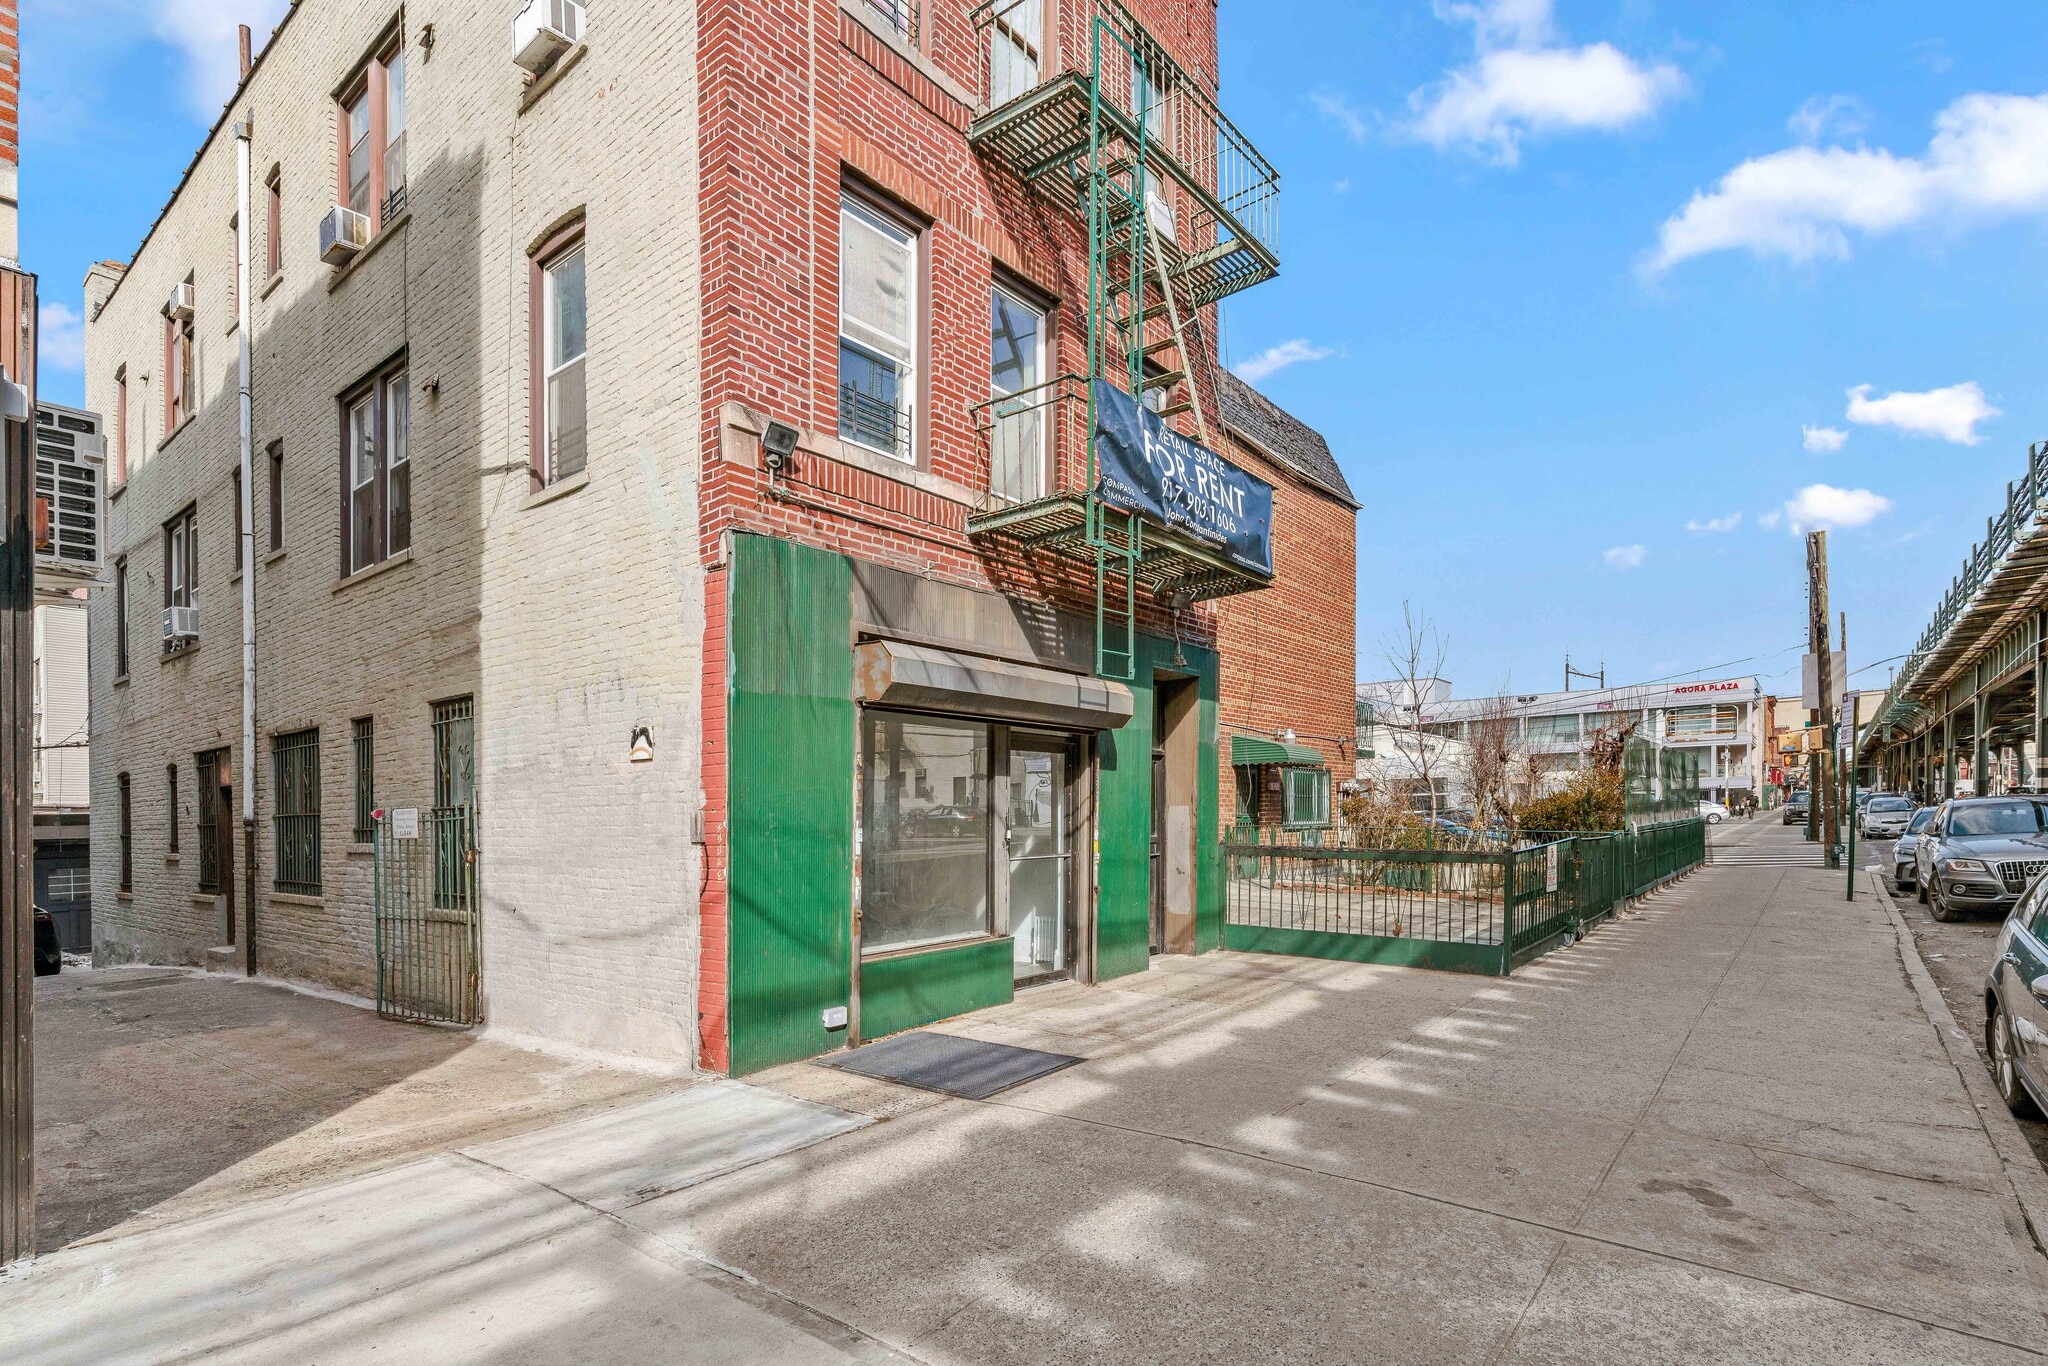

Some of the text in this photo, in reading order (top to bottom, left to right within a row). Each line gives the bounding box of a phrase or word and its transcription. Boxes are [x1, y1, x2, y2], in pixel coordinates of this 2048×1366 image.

[1143, 429, 1245, 518] FOR RENT
[1159, 426, 1226, 477] RETAIL SPACE
[1161, 477, 1237, 534] 917.903.1606
[1167, 509, 1185, 522] John
[1674, 683, 1739, 694] AGORA PLAZA
